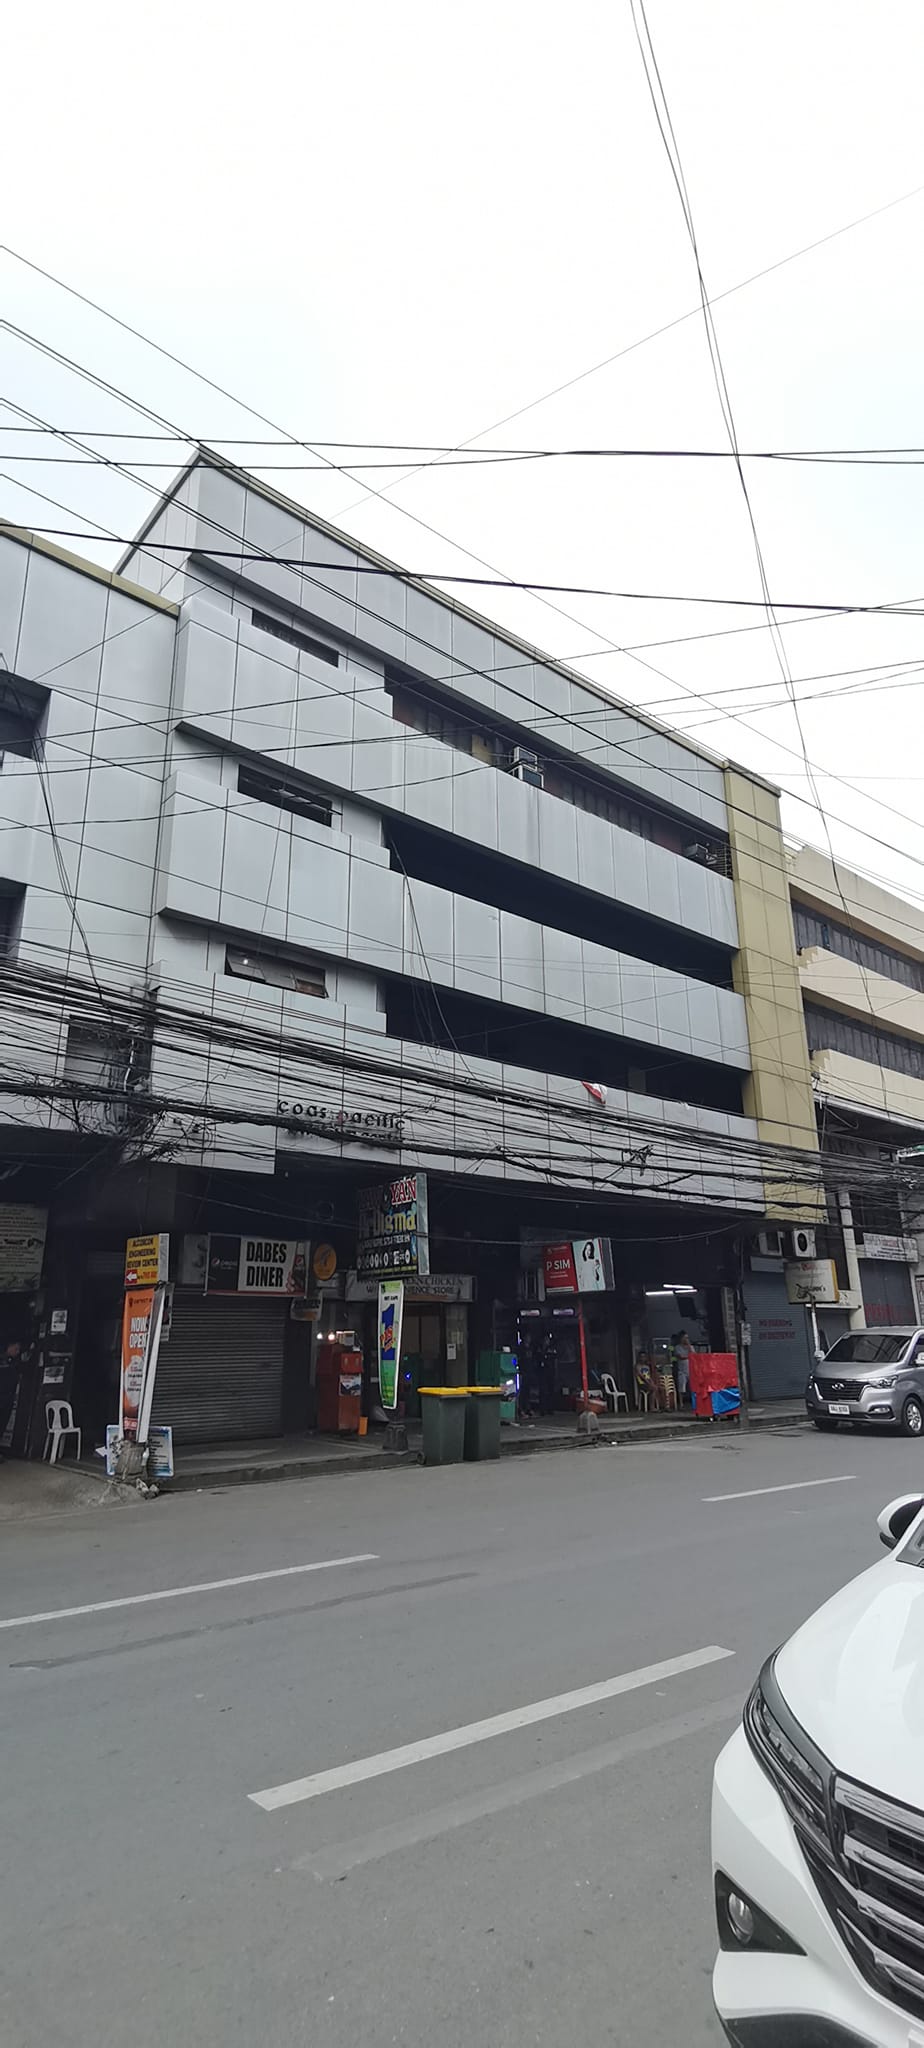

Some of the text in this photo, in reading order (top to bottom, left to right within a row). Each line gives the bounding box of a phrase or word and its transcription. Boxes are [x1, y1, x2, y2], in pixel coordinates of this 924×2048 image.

[246, 1241, 287, 1263] DABES
[142, 1258, 158, 1267] CENTER
[553, 1259, 570, 1270] SIM
[246, 1266, 284, 1287] DINER
[129, 1333, 148, 1349] OPEN
